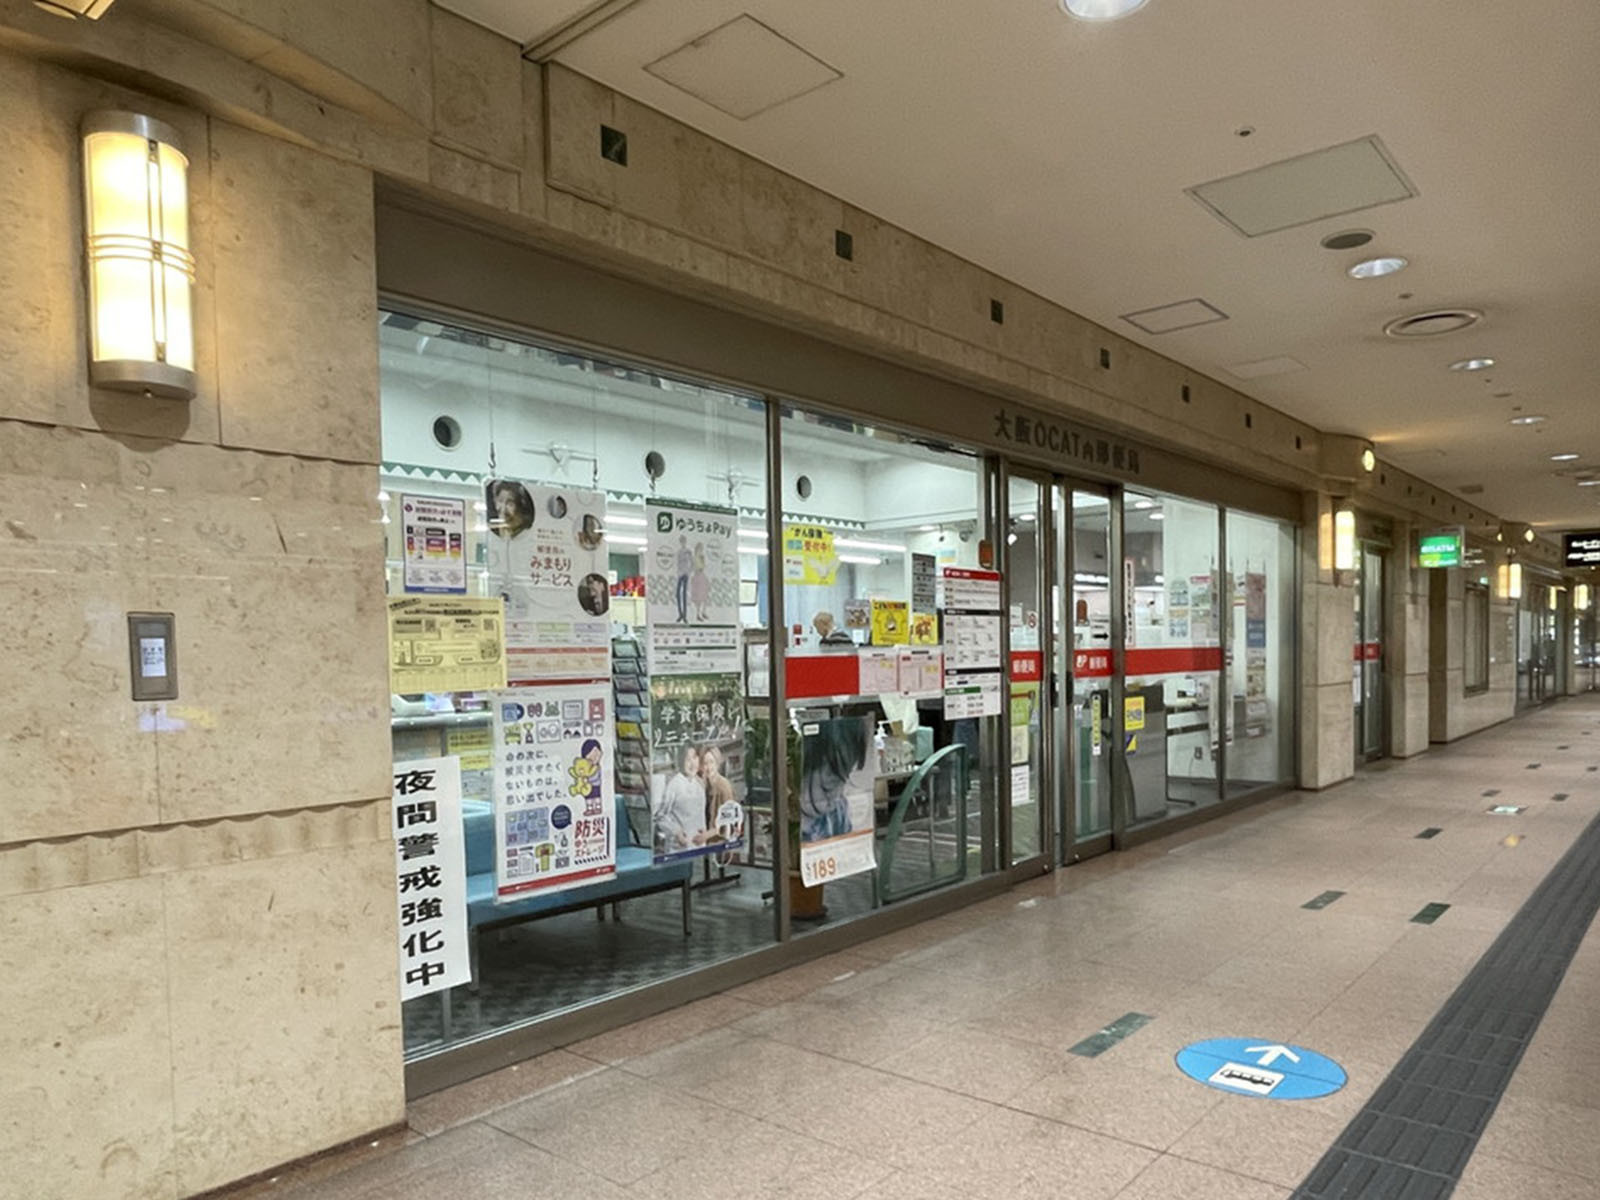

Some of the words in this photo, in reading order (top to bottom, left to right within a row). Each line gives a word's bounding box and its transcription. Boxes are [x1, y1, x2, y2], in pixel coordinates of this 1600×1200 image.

[676, 518, 732, 539] ゆうちょPay
[530, 555, 571, 572] みまもり
[530, 571, 574, 587] サービス
[574, 816, 605, 840] 防災
[394, 769, 446, 987] 夜間警戒強化中
[812, 857, 837, 880] 189
